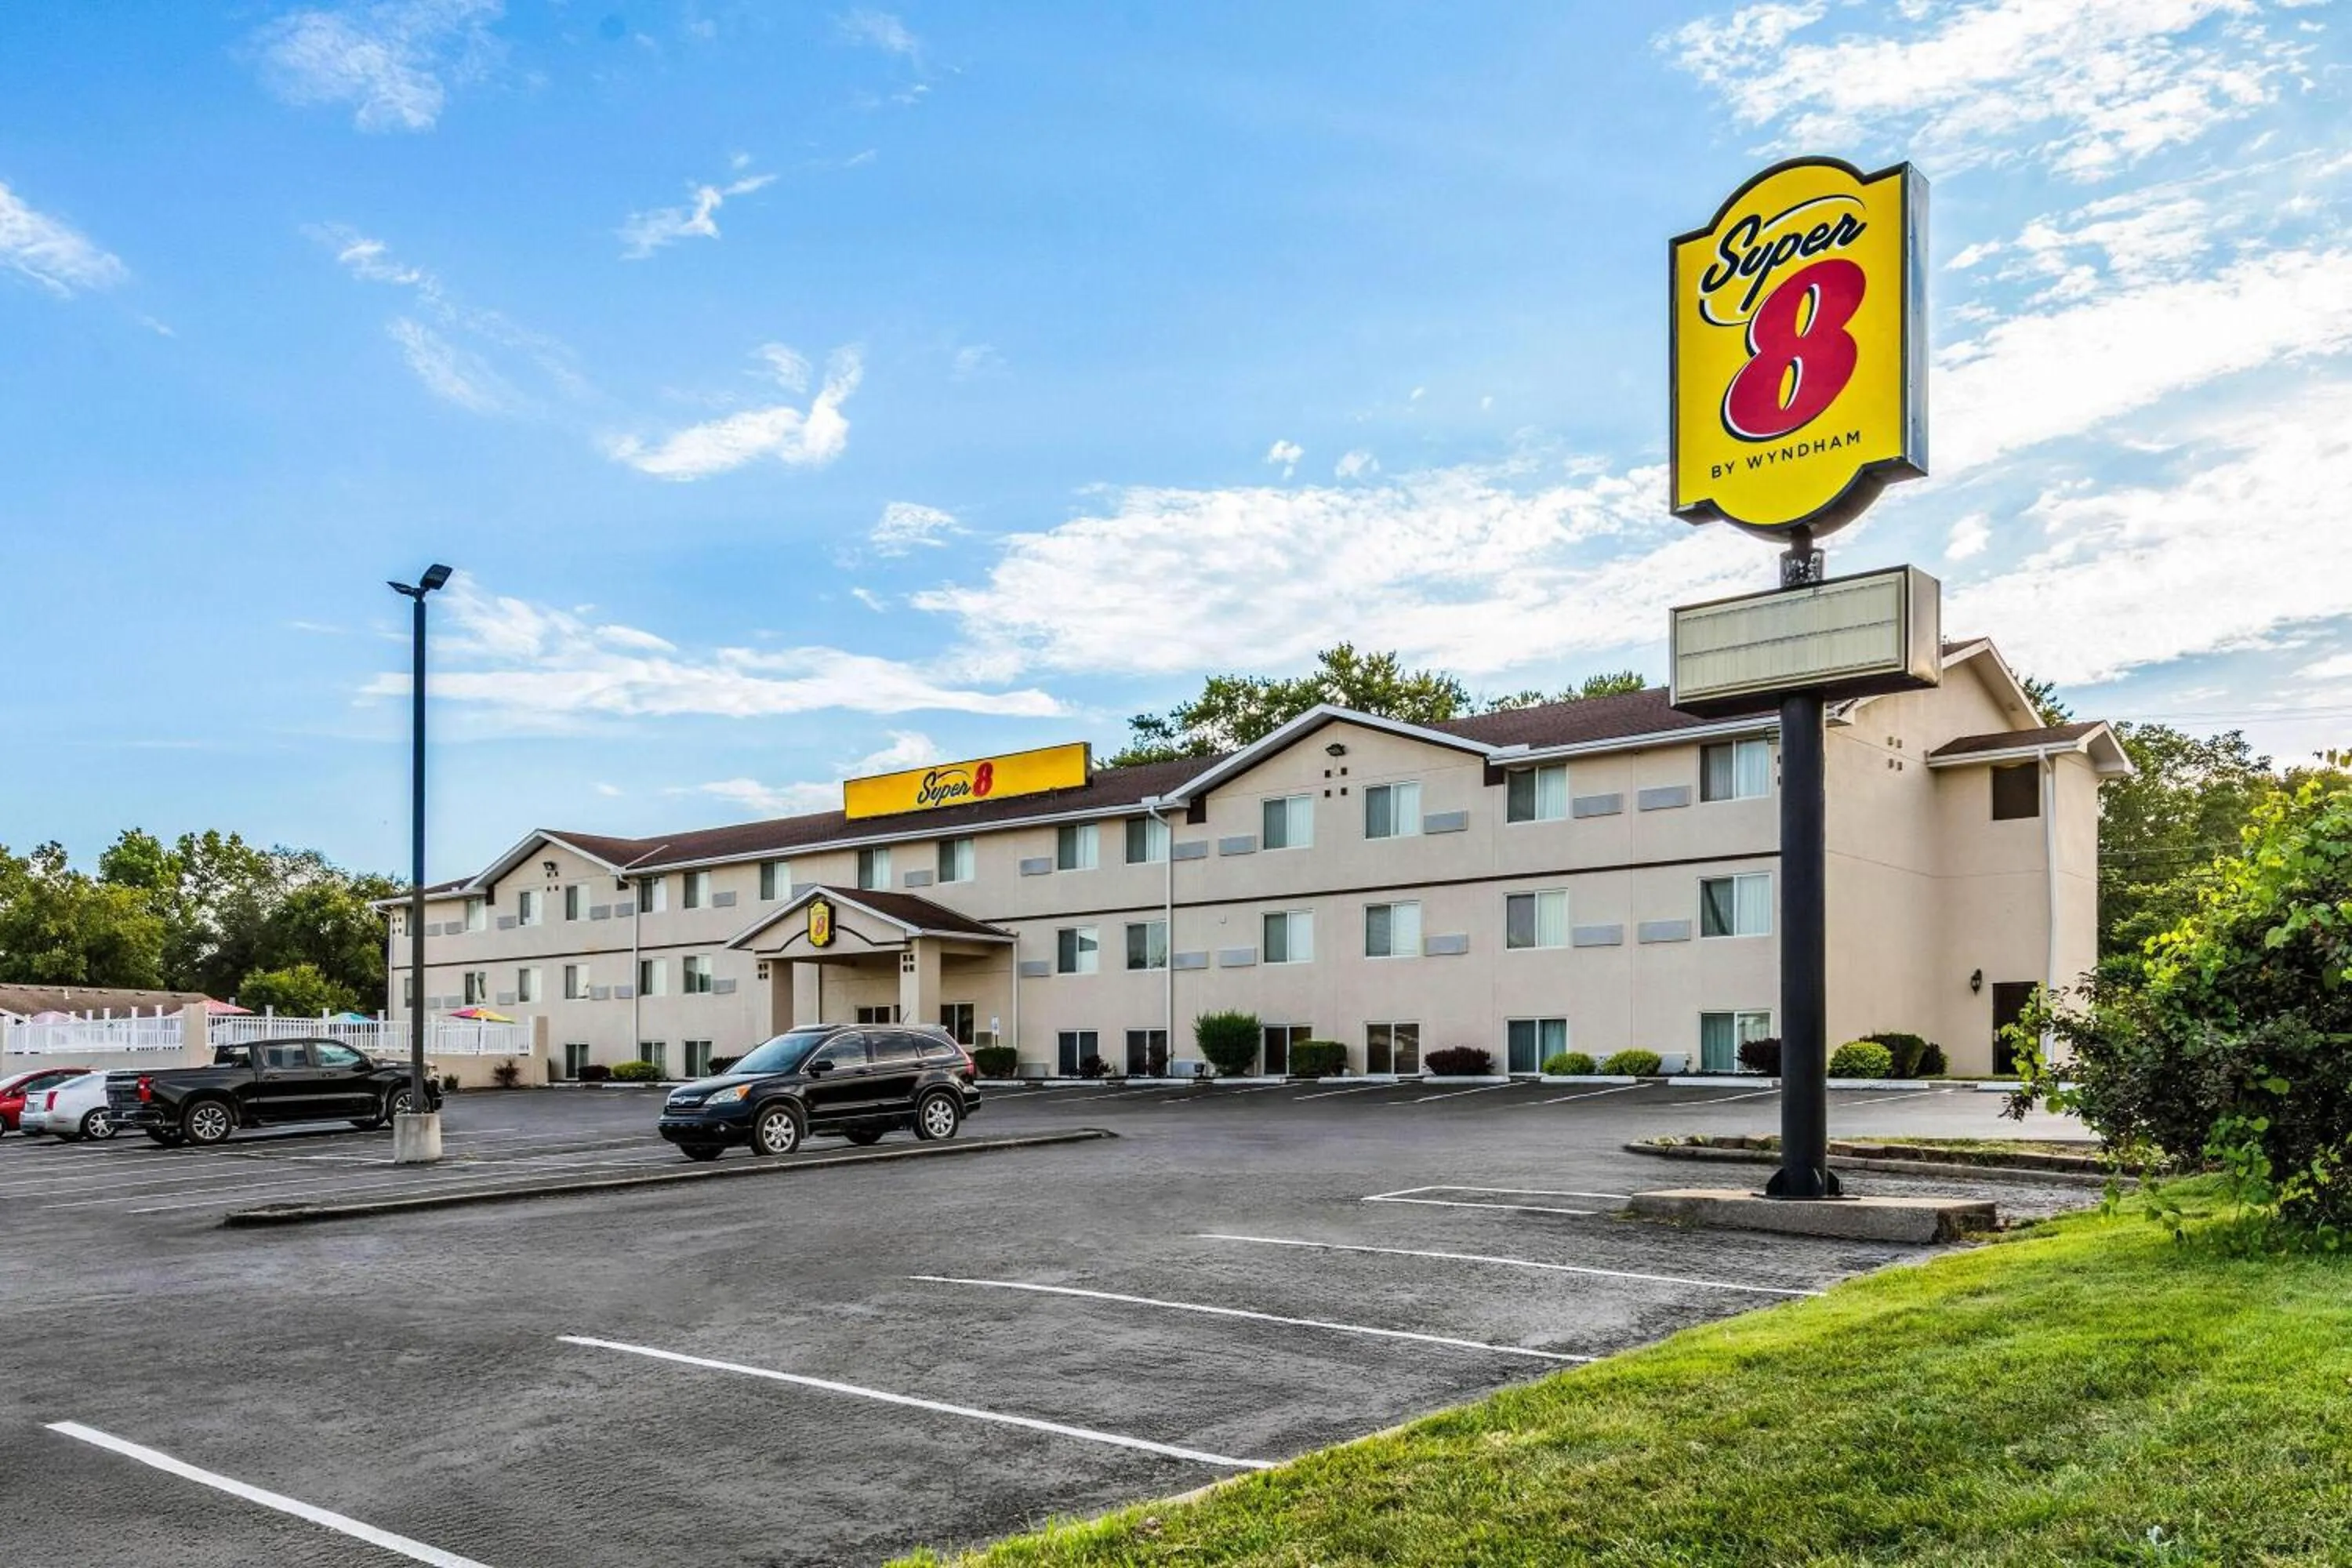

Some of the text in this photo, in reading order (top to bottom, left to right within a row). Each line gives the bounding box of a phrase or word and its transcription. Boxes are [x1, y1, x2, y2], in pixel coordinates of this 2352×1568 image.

[1700, 213, 1867, 313] Super
[1719, 258, 1867, 443] 8
[1711, 430, 1860, 479] BY WYNDHAM
[916, 761, 994, 807] Super 8
